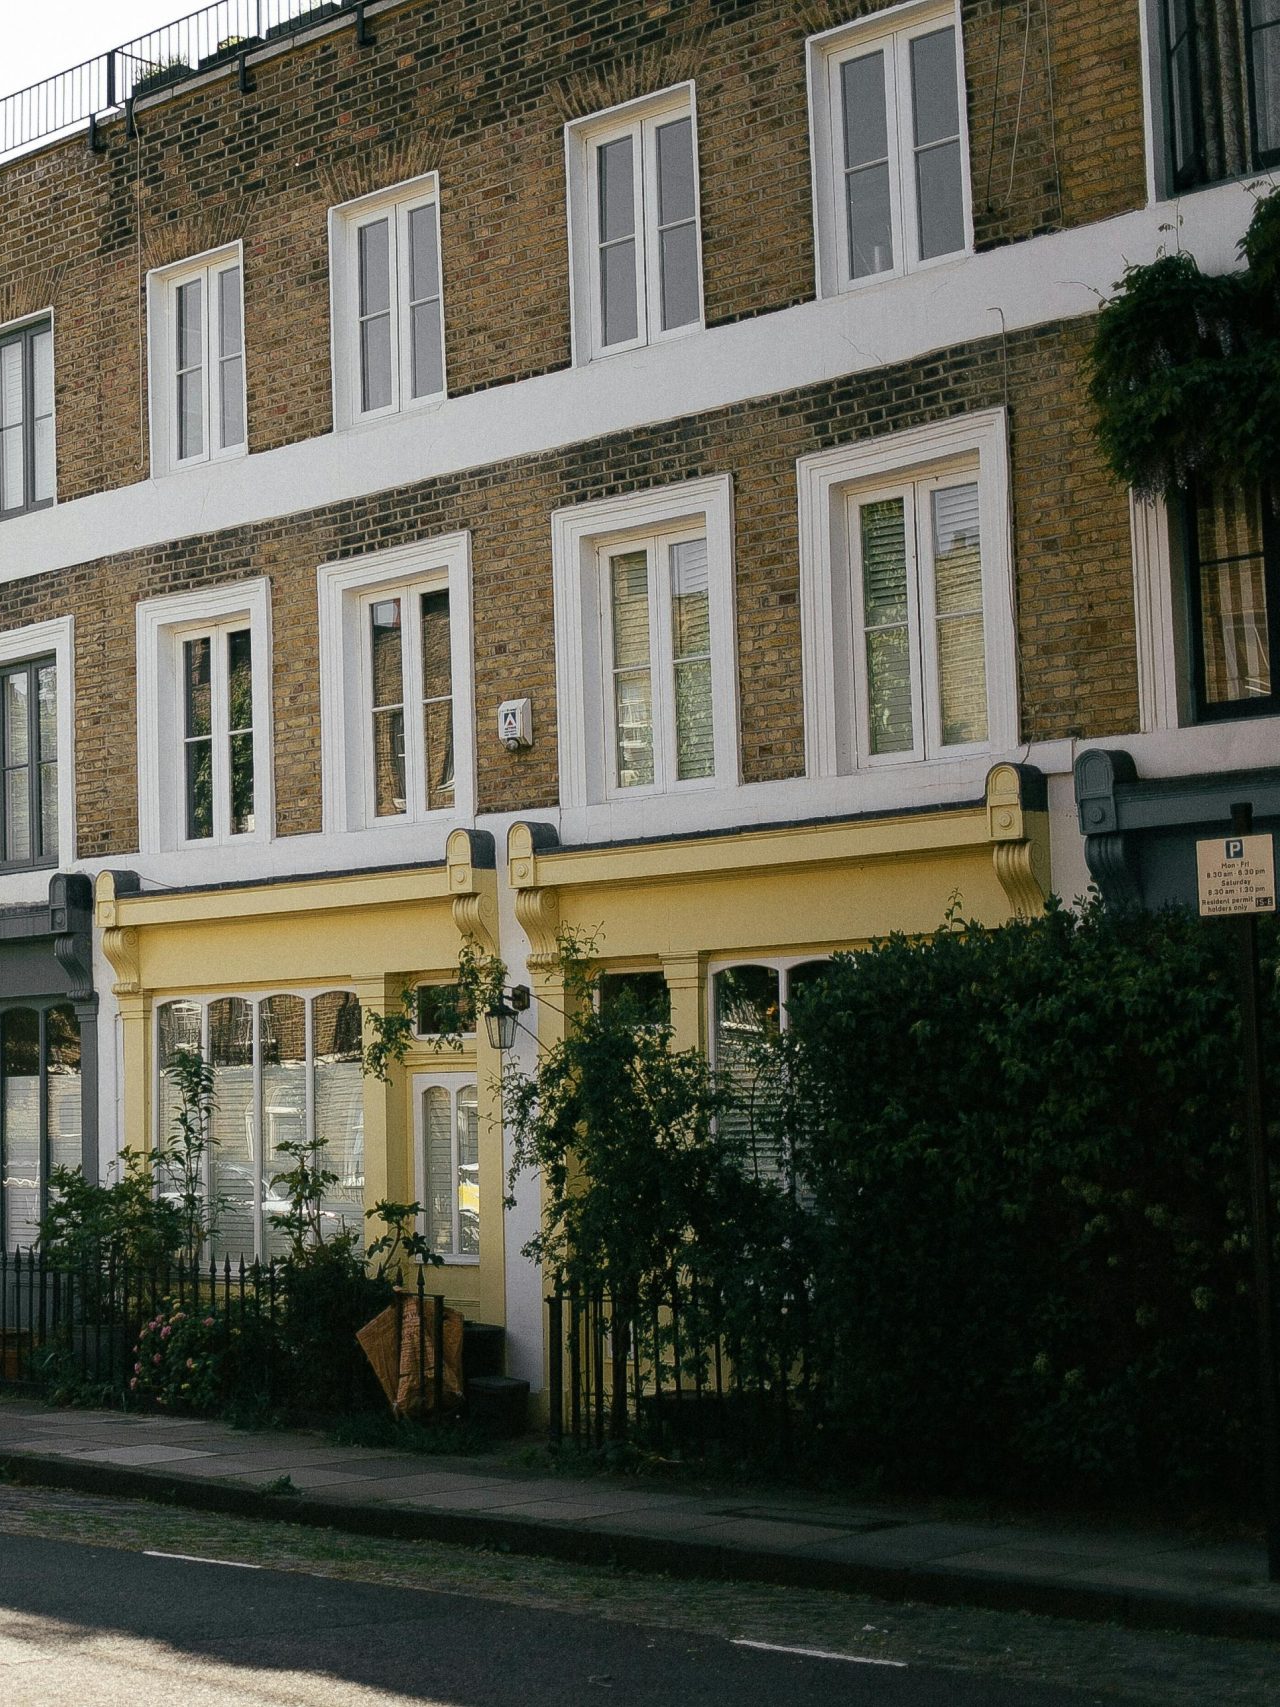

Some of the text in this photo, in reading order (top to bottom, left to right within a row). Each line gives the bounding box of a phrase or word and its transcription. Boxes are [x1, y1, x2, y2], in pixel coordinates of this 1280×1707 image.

[1230, 842, 1241, 858] P
[1206, 871, 1223, 879] 8.30
[1221, 879, 1251, 887] Saturday
[1208, 888, 1224, 896] 8.30
[1201, 898, 1230, 906] Resident
[1231, 896, 1254, 904] permit
[1207, 905, 1232, 913] holders
